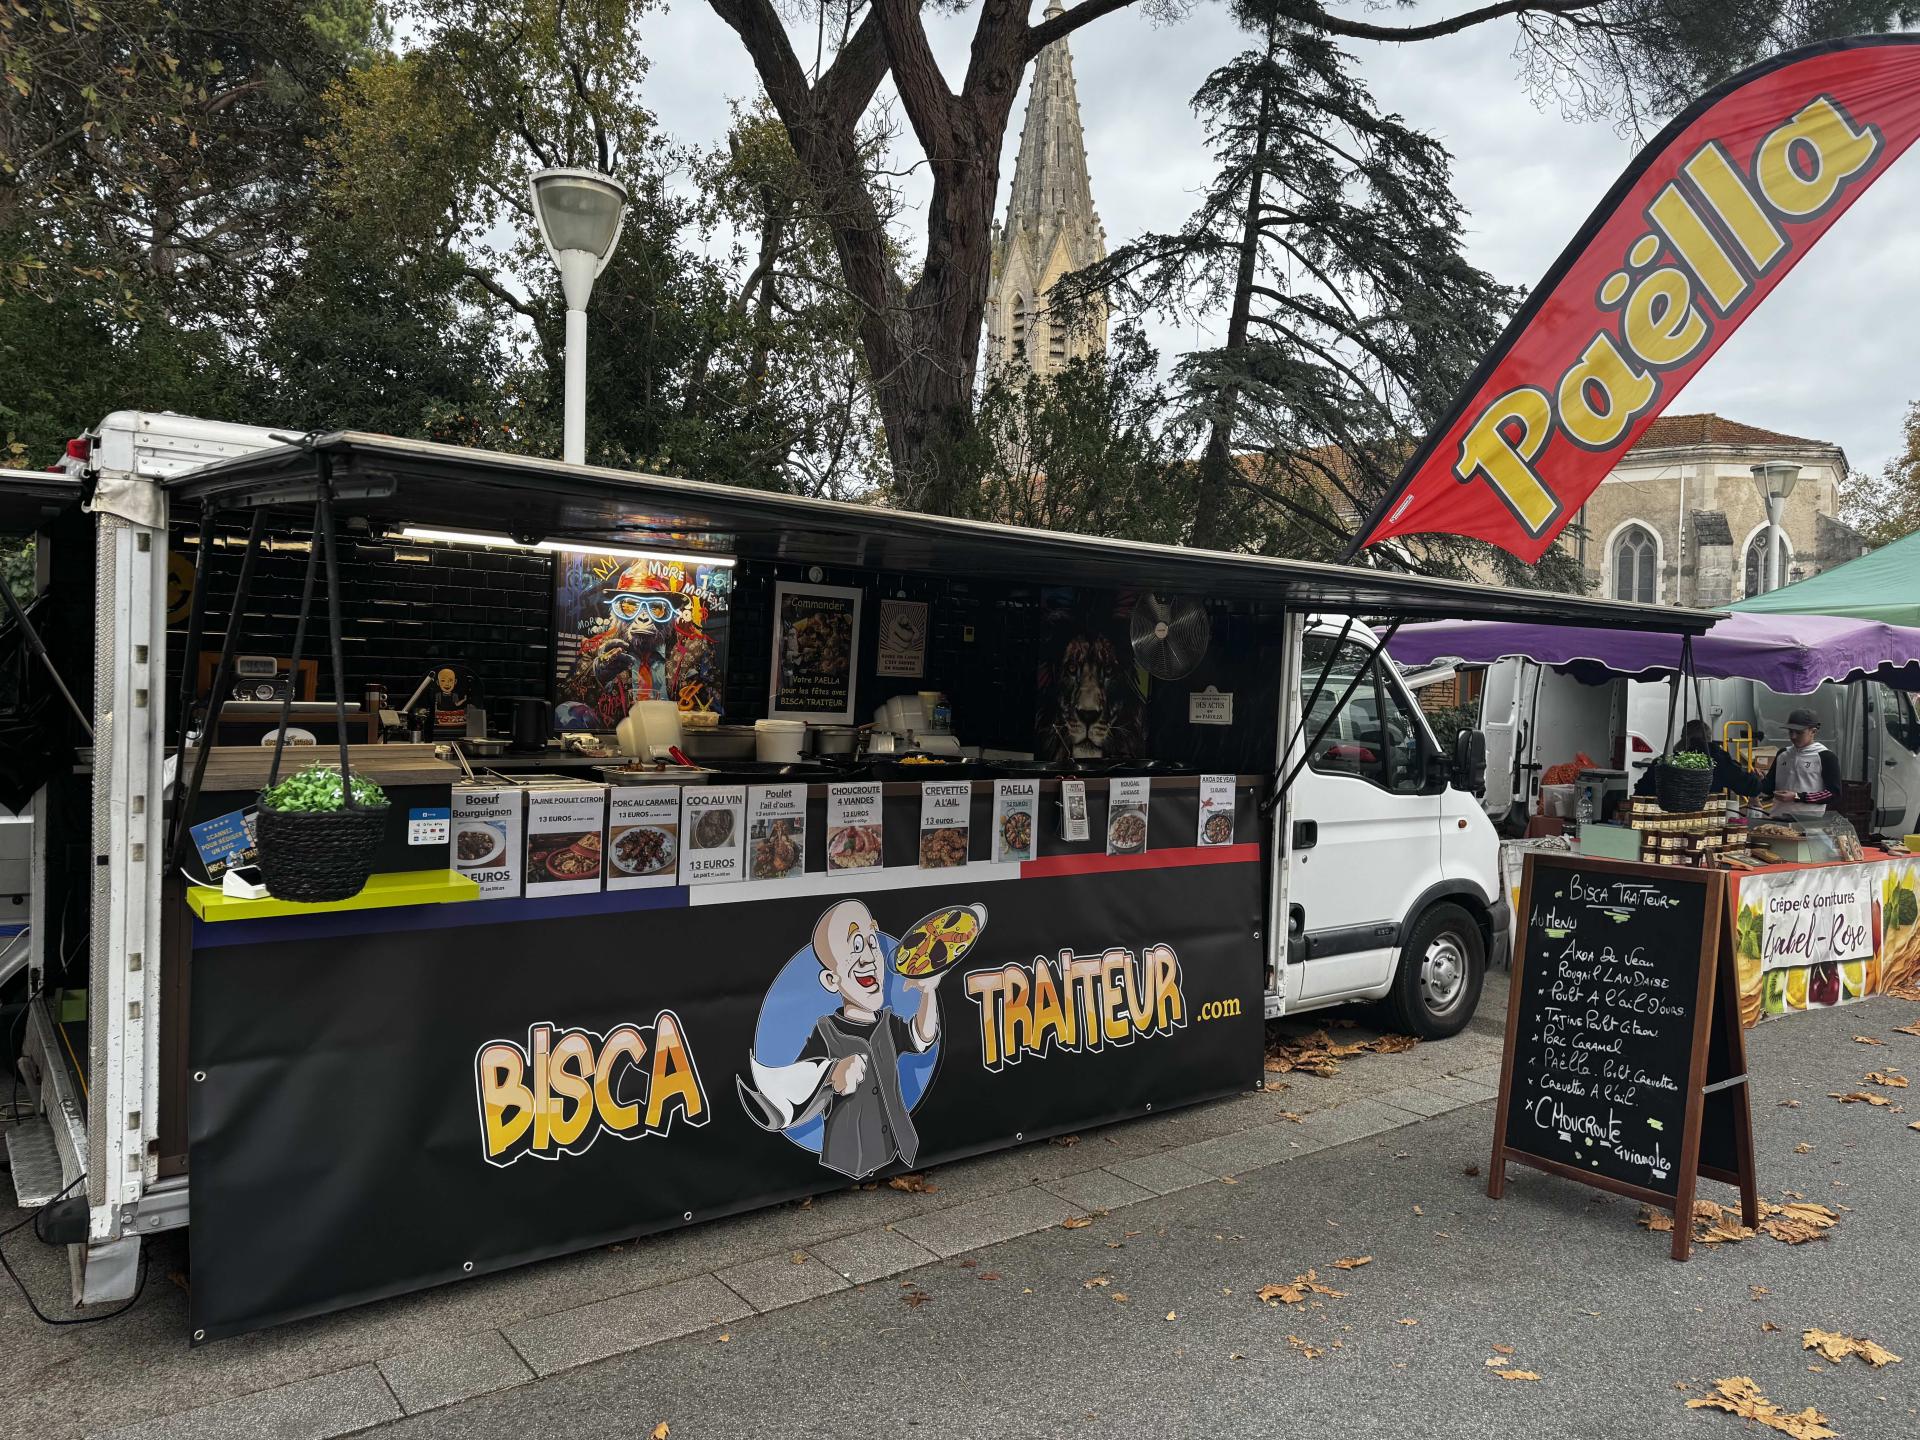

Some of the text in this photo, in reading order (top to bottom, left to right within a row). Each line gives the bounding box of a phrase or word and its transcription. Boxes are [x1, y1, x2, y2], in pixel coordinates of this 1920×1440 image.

[1452, 93, 1884, 538] Paëlla
[649, 561, 685, 581] MORE
[791, 597, 845, 611] Commander
[792, 676, 840, 685] Votre PAELLA
[780, 697, 803, 706] BISCA
[765, 789, 792, 798] Poulet
[831, 786, 880, 795] CHOUCROUTE
[925, 786, 969, 795] CREVETTES
[1000, 785, 1034, 795] PAELLA
[465, 793, 500, 805] Boeuf
[645, 799, 678, 807] CARAMEL
[686, 795, 742, 805] COQ AU VIN
[843, 796, 874, 805] VIANDES
[934, 799, 941, 807] A
[452, 808, 512, 819] Bourguignon
[201, 840, 218, 852] POUR
[211, 847, 221, 856] UN
[690, 858, 735, 870] 13 EUROS
[470, 871, 511, 883] EUROS
[1802, 894, 1810, 909] &
[478, 945, 1241, 1163] BISCA TRAITEUR .com
